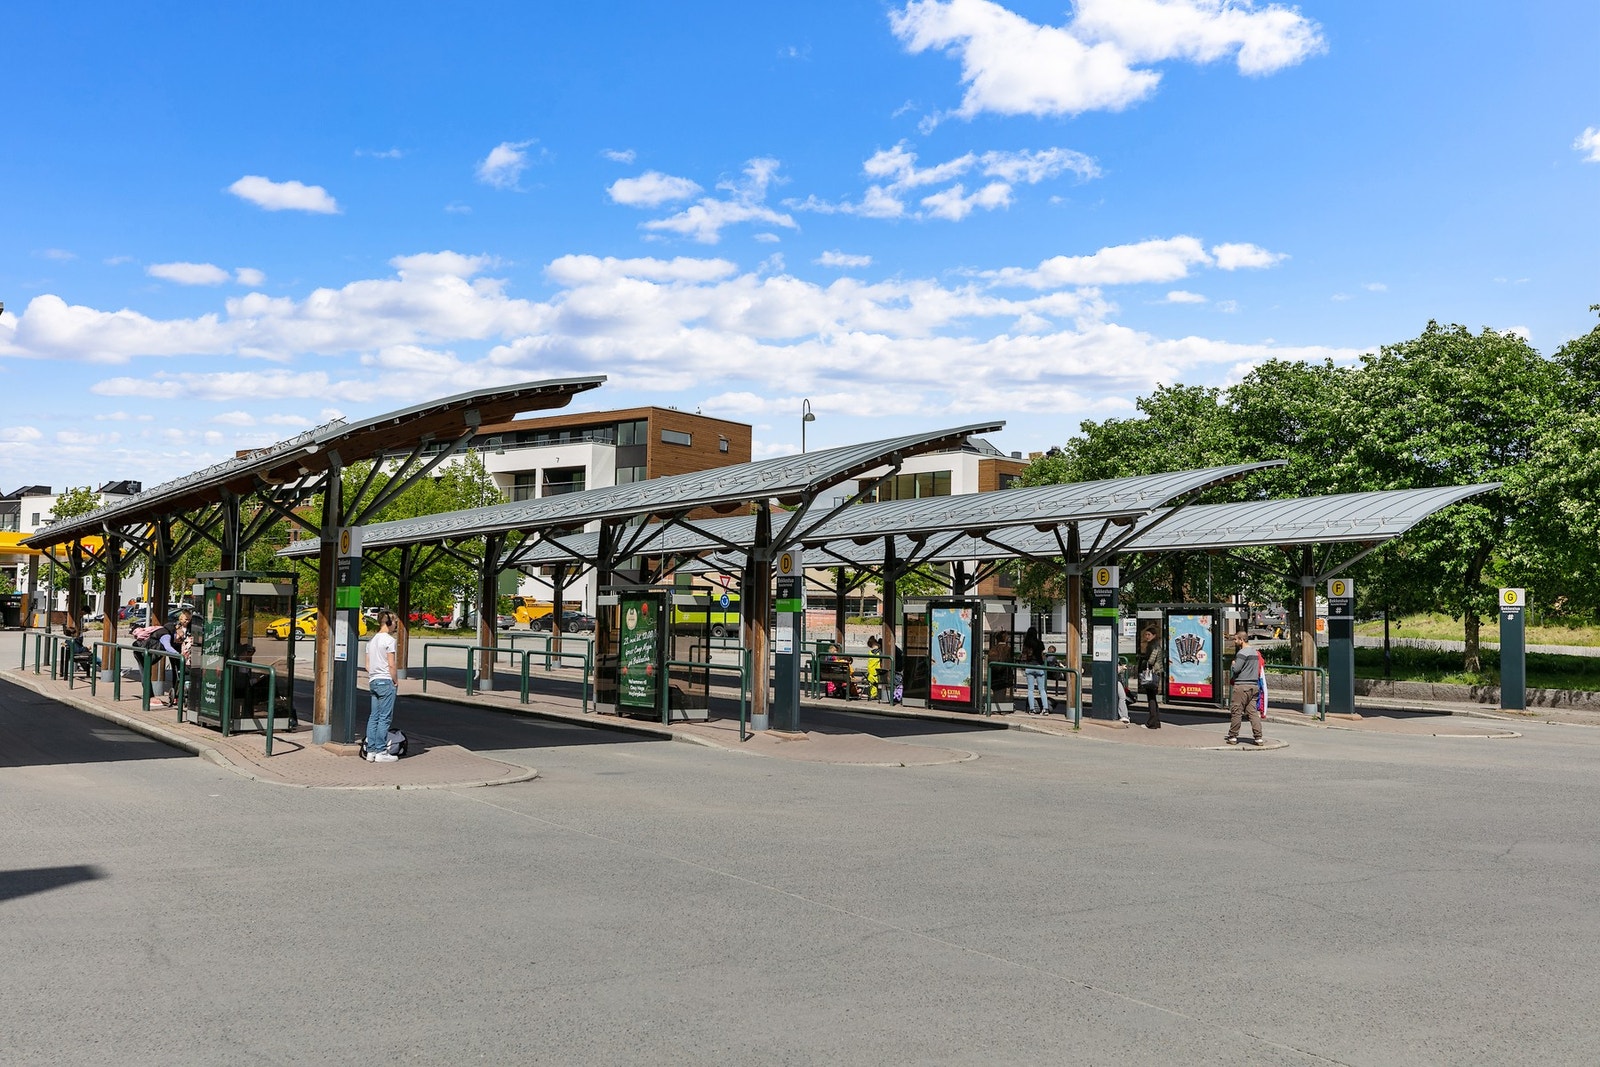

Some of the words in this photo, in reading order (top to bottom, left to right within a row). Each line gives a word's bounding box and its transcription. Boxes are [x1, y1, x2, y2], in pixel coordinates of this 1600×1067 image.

[784, 558, 789, 569] D
[1101, 572, 1106, 581] E
[1336, 584, 1341, 592] F
[1508, 593, 1513, 601] G
